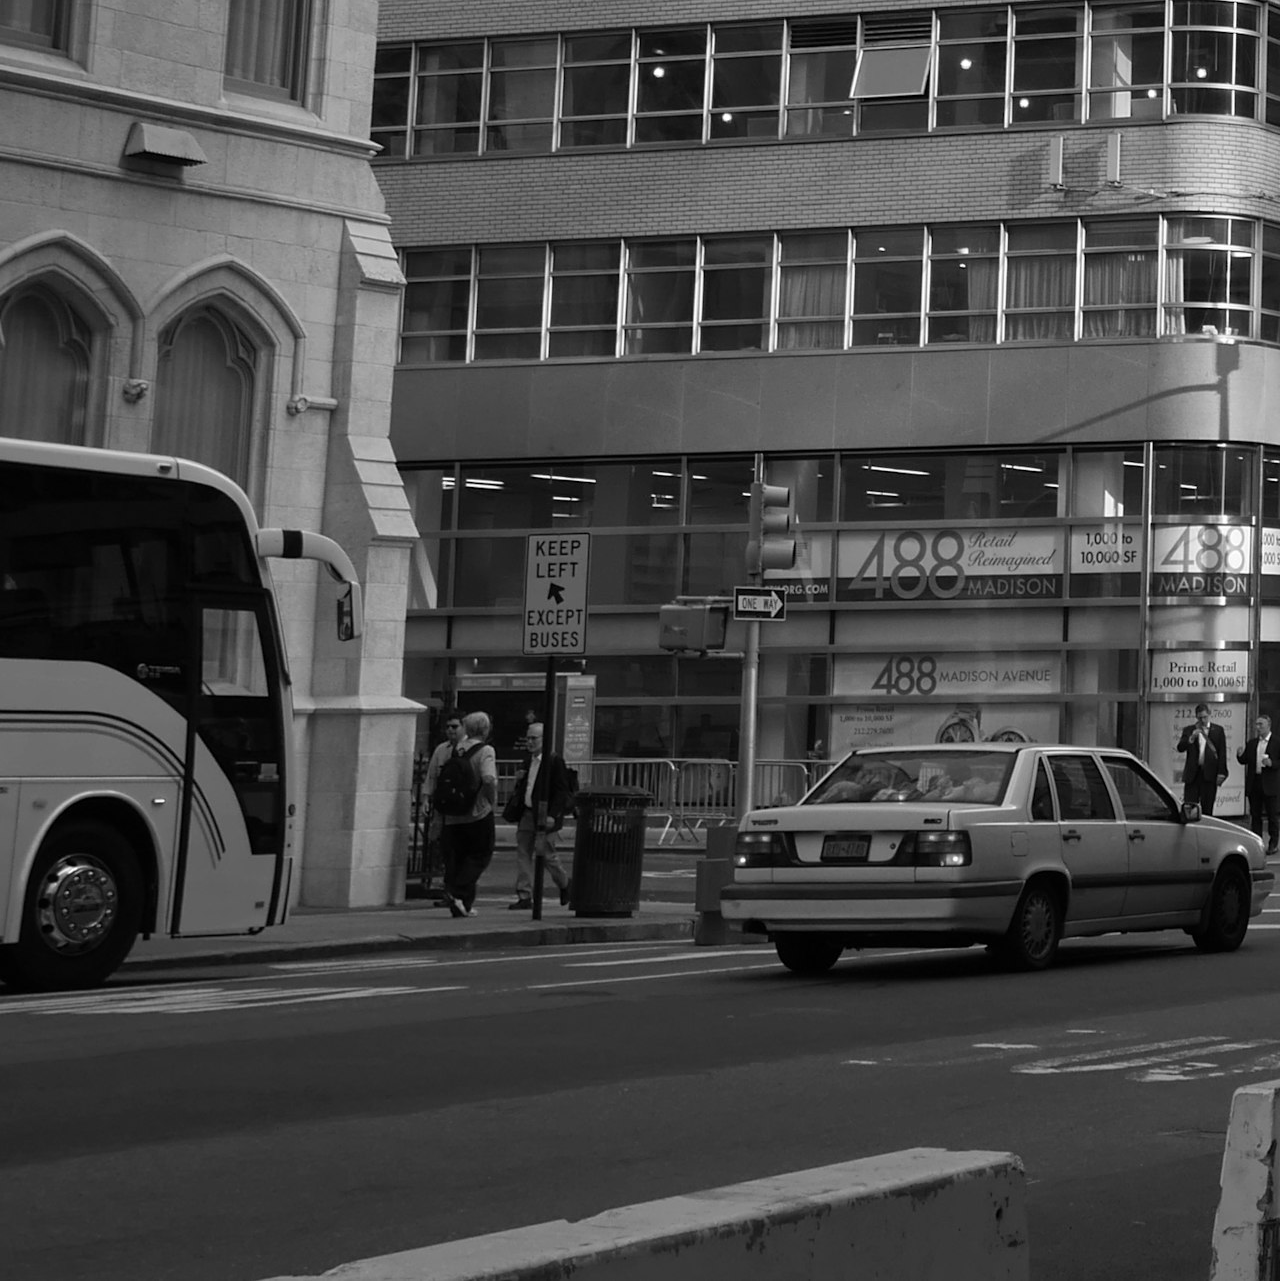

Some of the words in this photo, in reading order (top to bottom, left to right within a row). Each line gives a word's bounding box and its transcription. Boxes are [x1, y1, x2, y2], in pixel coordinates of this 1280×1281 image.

[535, 539, 581, 556] KEEP
[968, 531, 1018, 549] Retail
[1086, 533, 1118, 548] 1,000
[1122, 532, 1133, 545] to
[1081, 551, 1120, 566] 10,000
[1123, 550, 1137, 564] SF
[1161, 526, 1245, 573] 488
[848, 530, 966, 599] 488
[968, 549, 1057, 572] Reimagined
[536, 562, 578, 579] LEFT
[968, 578, 1056, 596] MADISON
[1159, 576, 1247, 594] MADISON
[742, 598, 758, 610] ONE
[763, 598, 779, 611] WAY
[527, 609, 583, 626] EXCEPT
[530, 631, 579, 648] BUSES
[871, 655, 937, 695] 488
[939, 670, 998, 683] MADISON
[1002, 669, 1052, 682] AVENUE
[1170, 661, 1204, 674] Prime
[1208, 661, 1237, 673] Retail
[1153, 677, 1184, 689] 1,000
[1187, 678, 1198, 688] to
[1202, 677, 1235, 689] 10,000
[1236, 676, 1247, 688] SF
